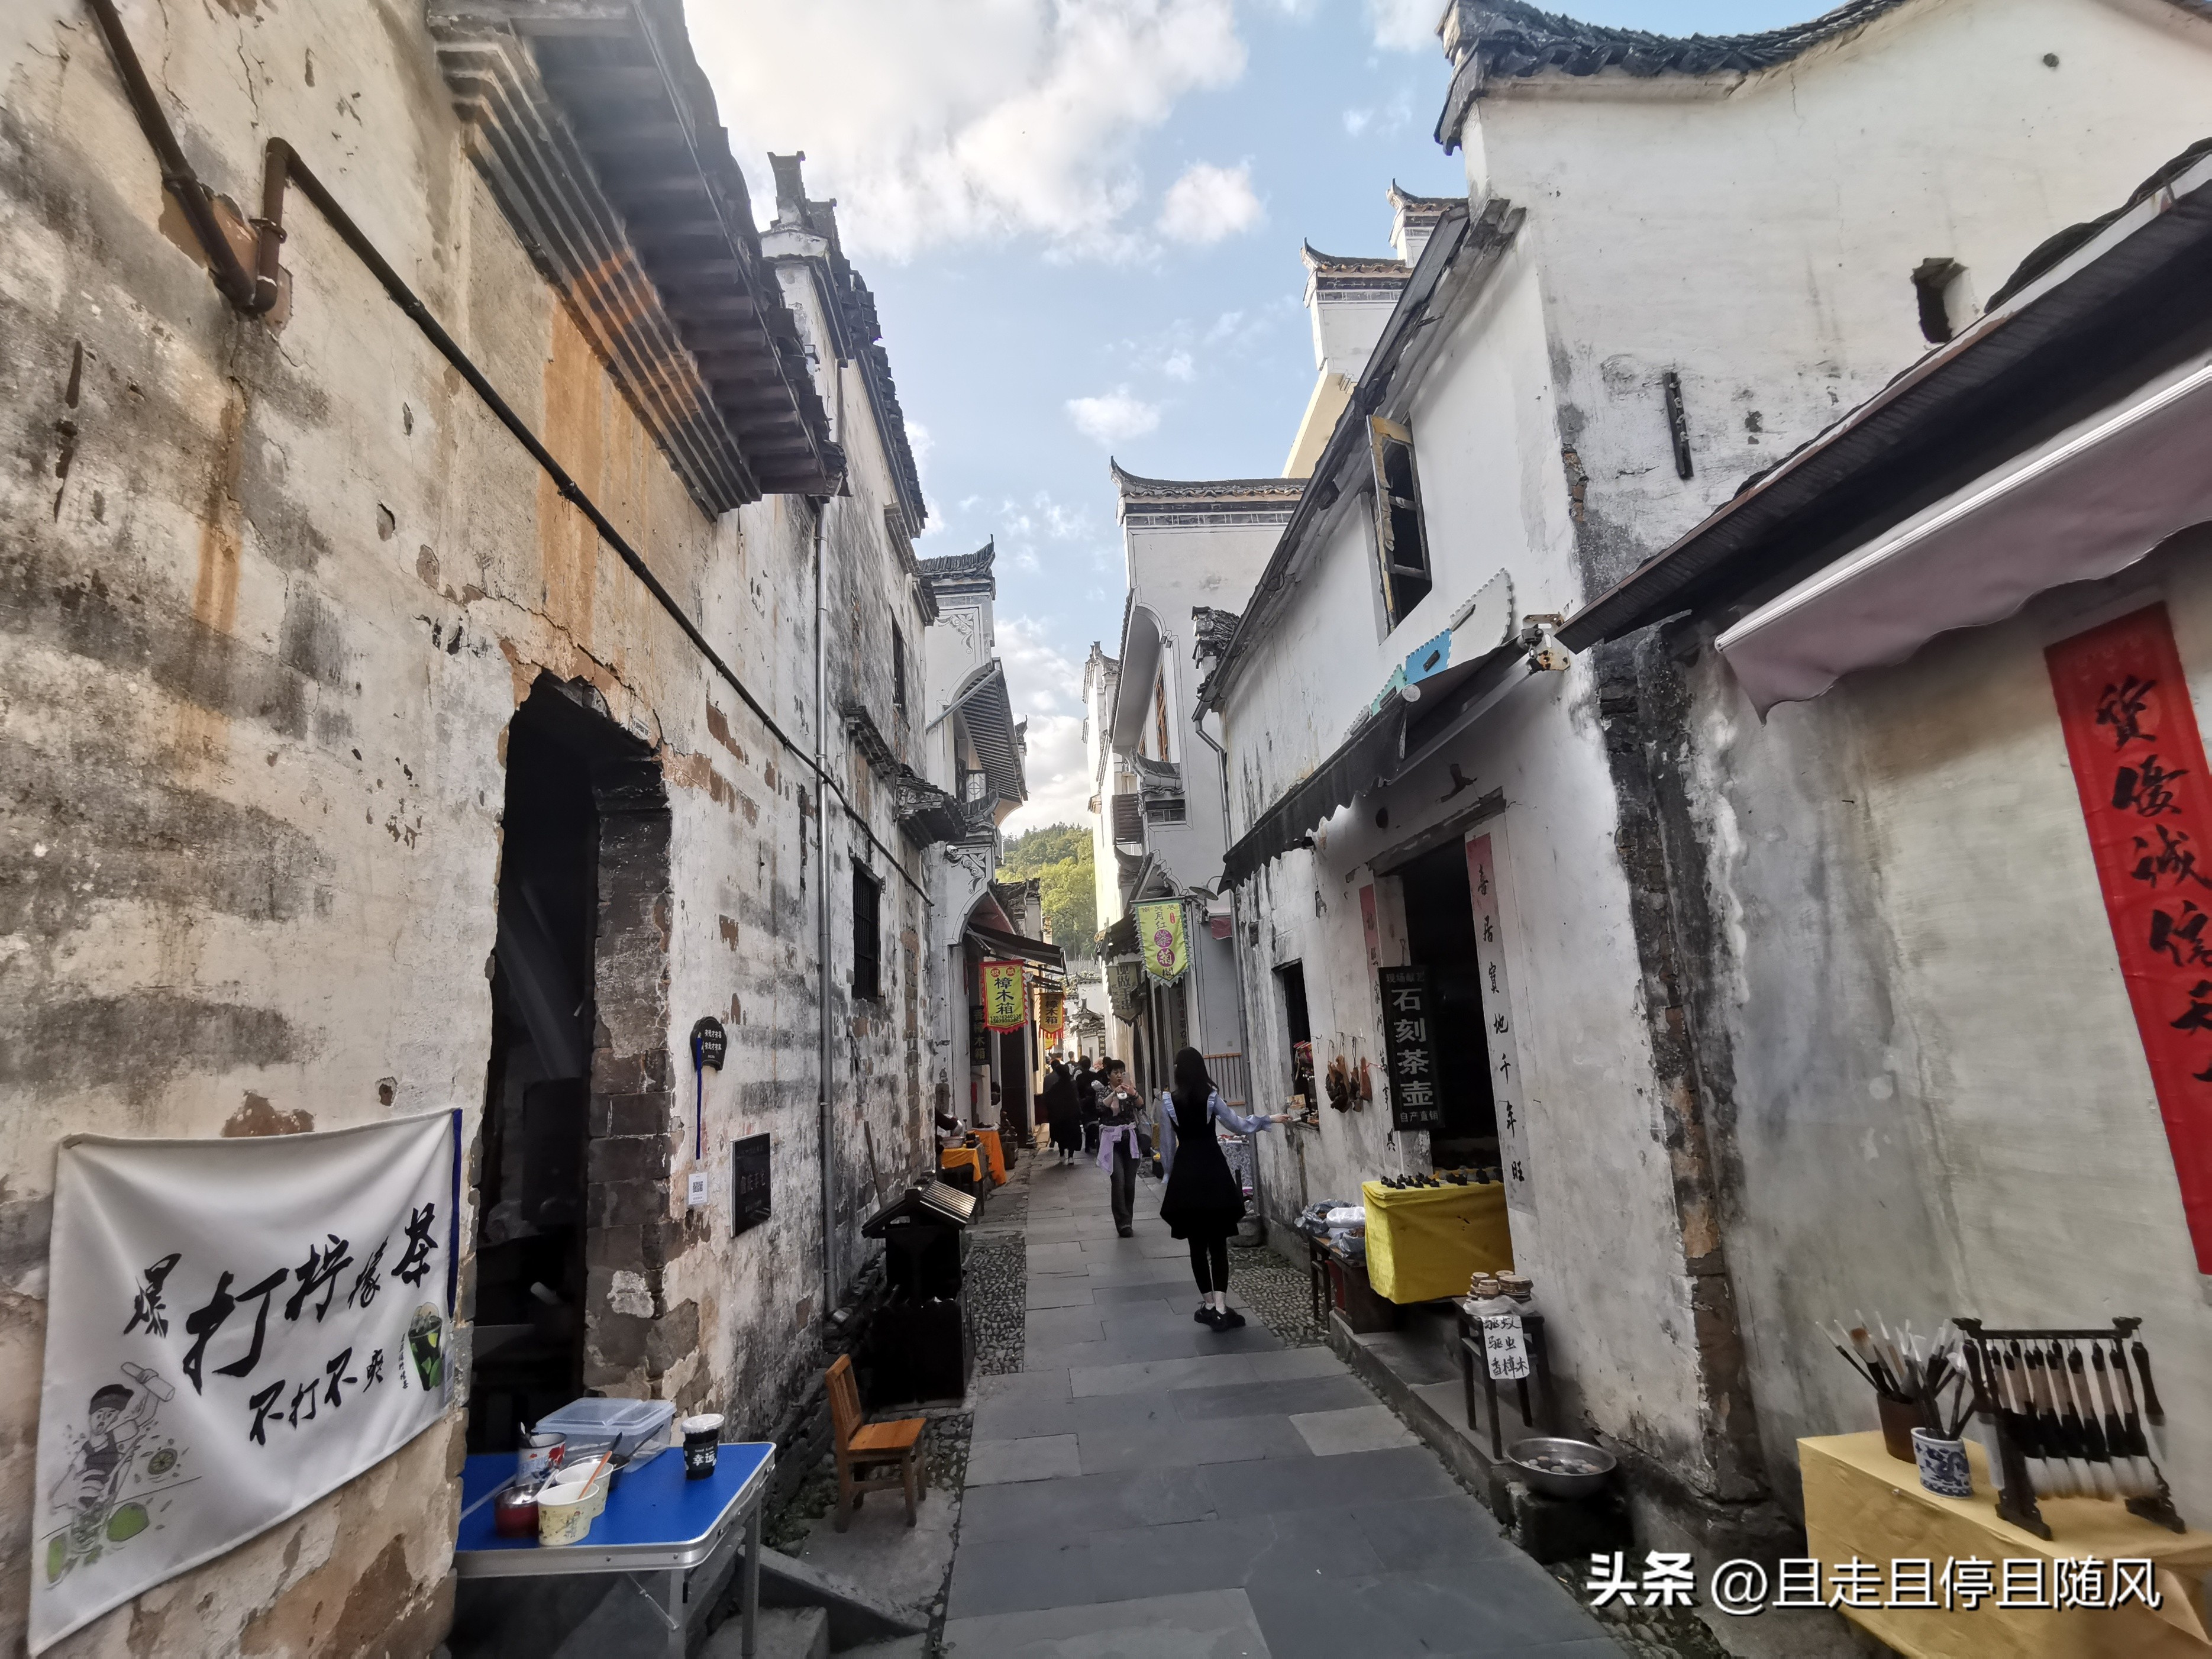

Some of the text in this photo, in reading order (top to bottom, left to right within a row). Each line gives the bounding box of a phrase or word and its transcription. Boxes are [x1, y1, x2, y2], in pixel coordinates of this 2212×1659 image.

[994, 977, 1015, 1015] 樟木箱
[1391, 987, 1434, 1106] 石刻茶壶
[1400, 1110, 1439, 1123] 自产直销
[1487, 1335, 1517, 1351] 驱虫
[1491, 1355, 1528, 1378] 香樟木
[249, 1347, 384, 1445] 不打不爽
[692, 1451, 715, 1466] 幸运
